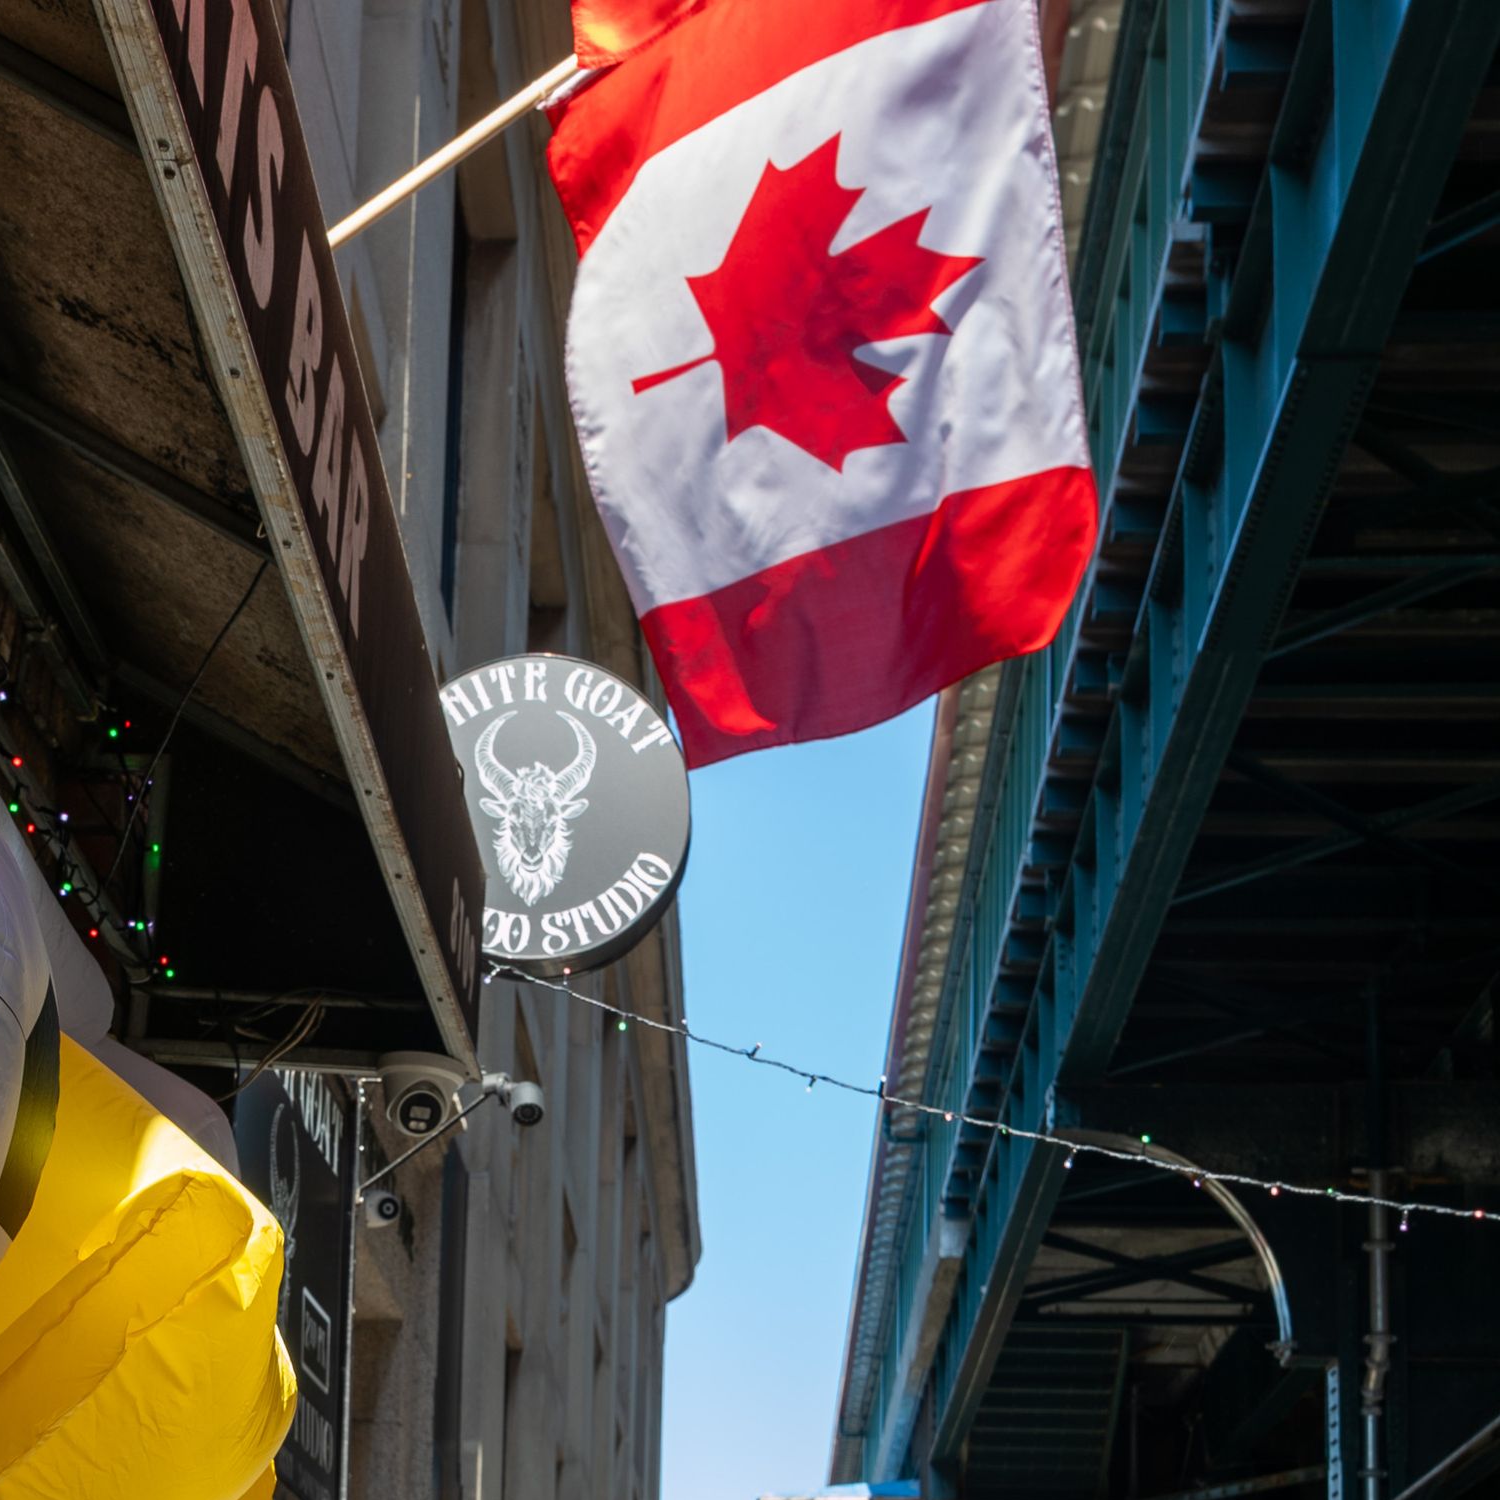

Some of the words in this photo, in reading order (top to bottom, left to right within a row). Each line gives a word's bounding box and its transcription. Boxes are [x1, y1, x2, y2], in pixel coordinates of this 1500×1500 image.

[285, 228, 369, 640] BAR
[439, 662, 547, 726] HITE
[564, 667, 672, 754] GOAT
[541, 852, 672, 955] STUDIO
